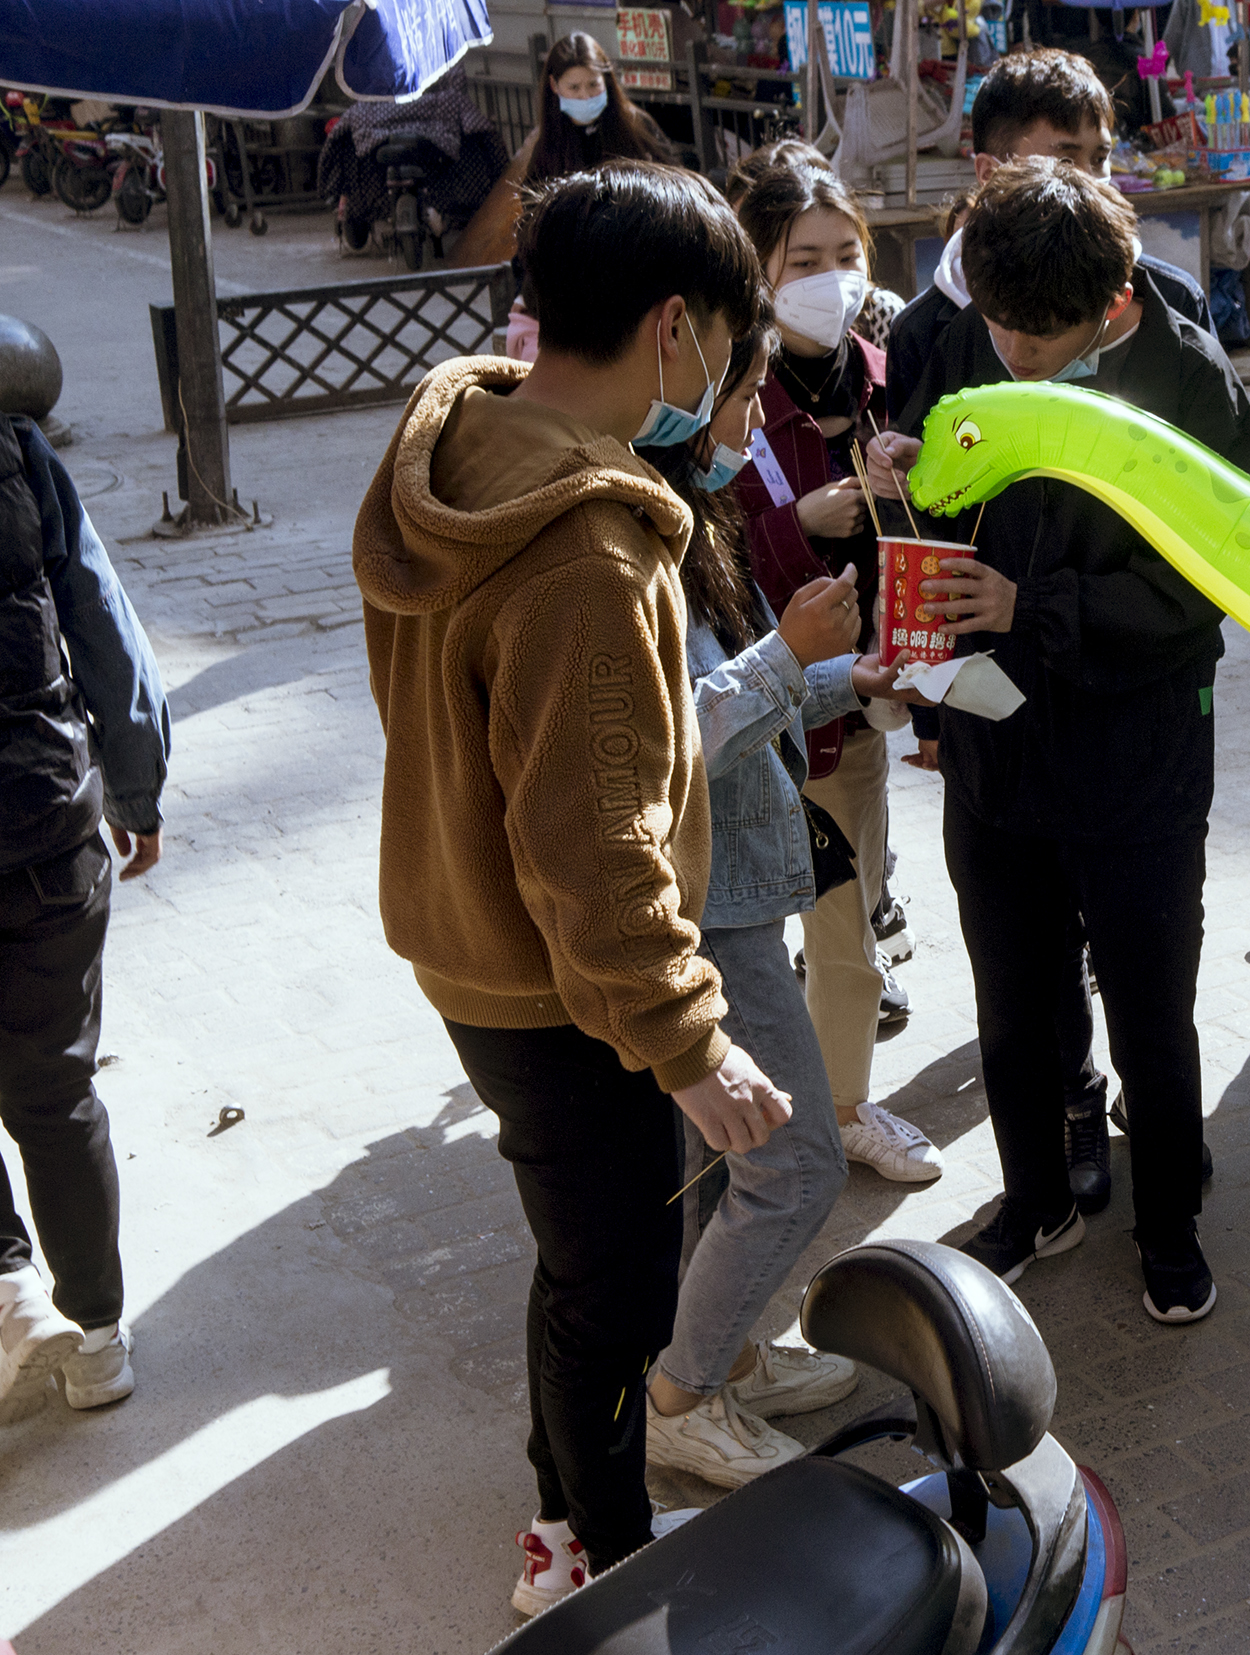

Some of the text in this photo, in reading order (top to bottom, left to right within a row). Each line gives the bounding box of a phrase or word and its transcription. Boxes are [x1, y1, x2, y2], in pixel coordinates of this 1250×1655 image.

[786, 5, 875, 78] 钢膜10元
[590, 652, 656, 847] AMOUR
